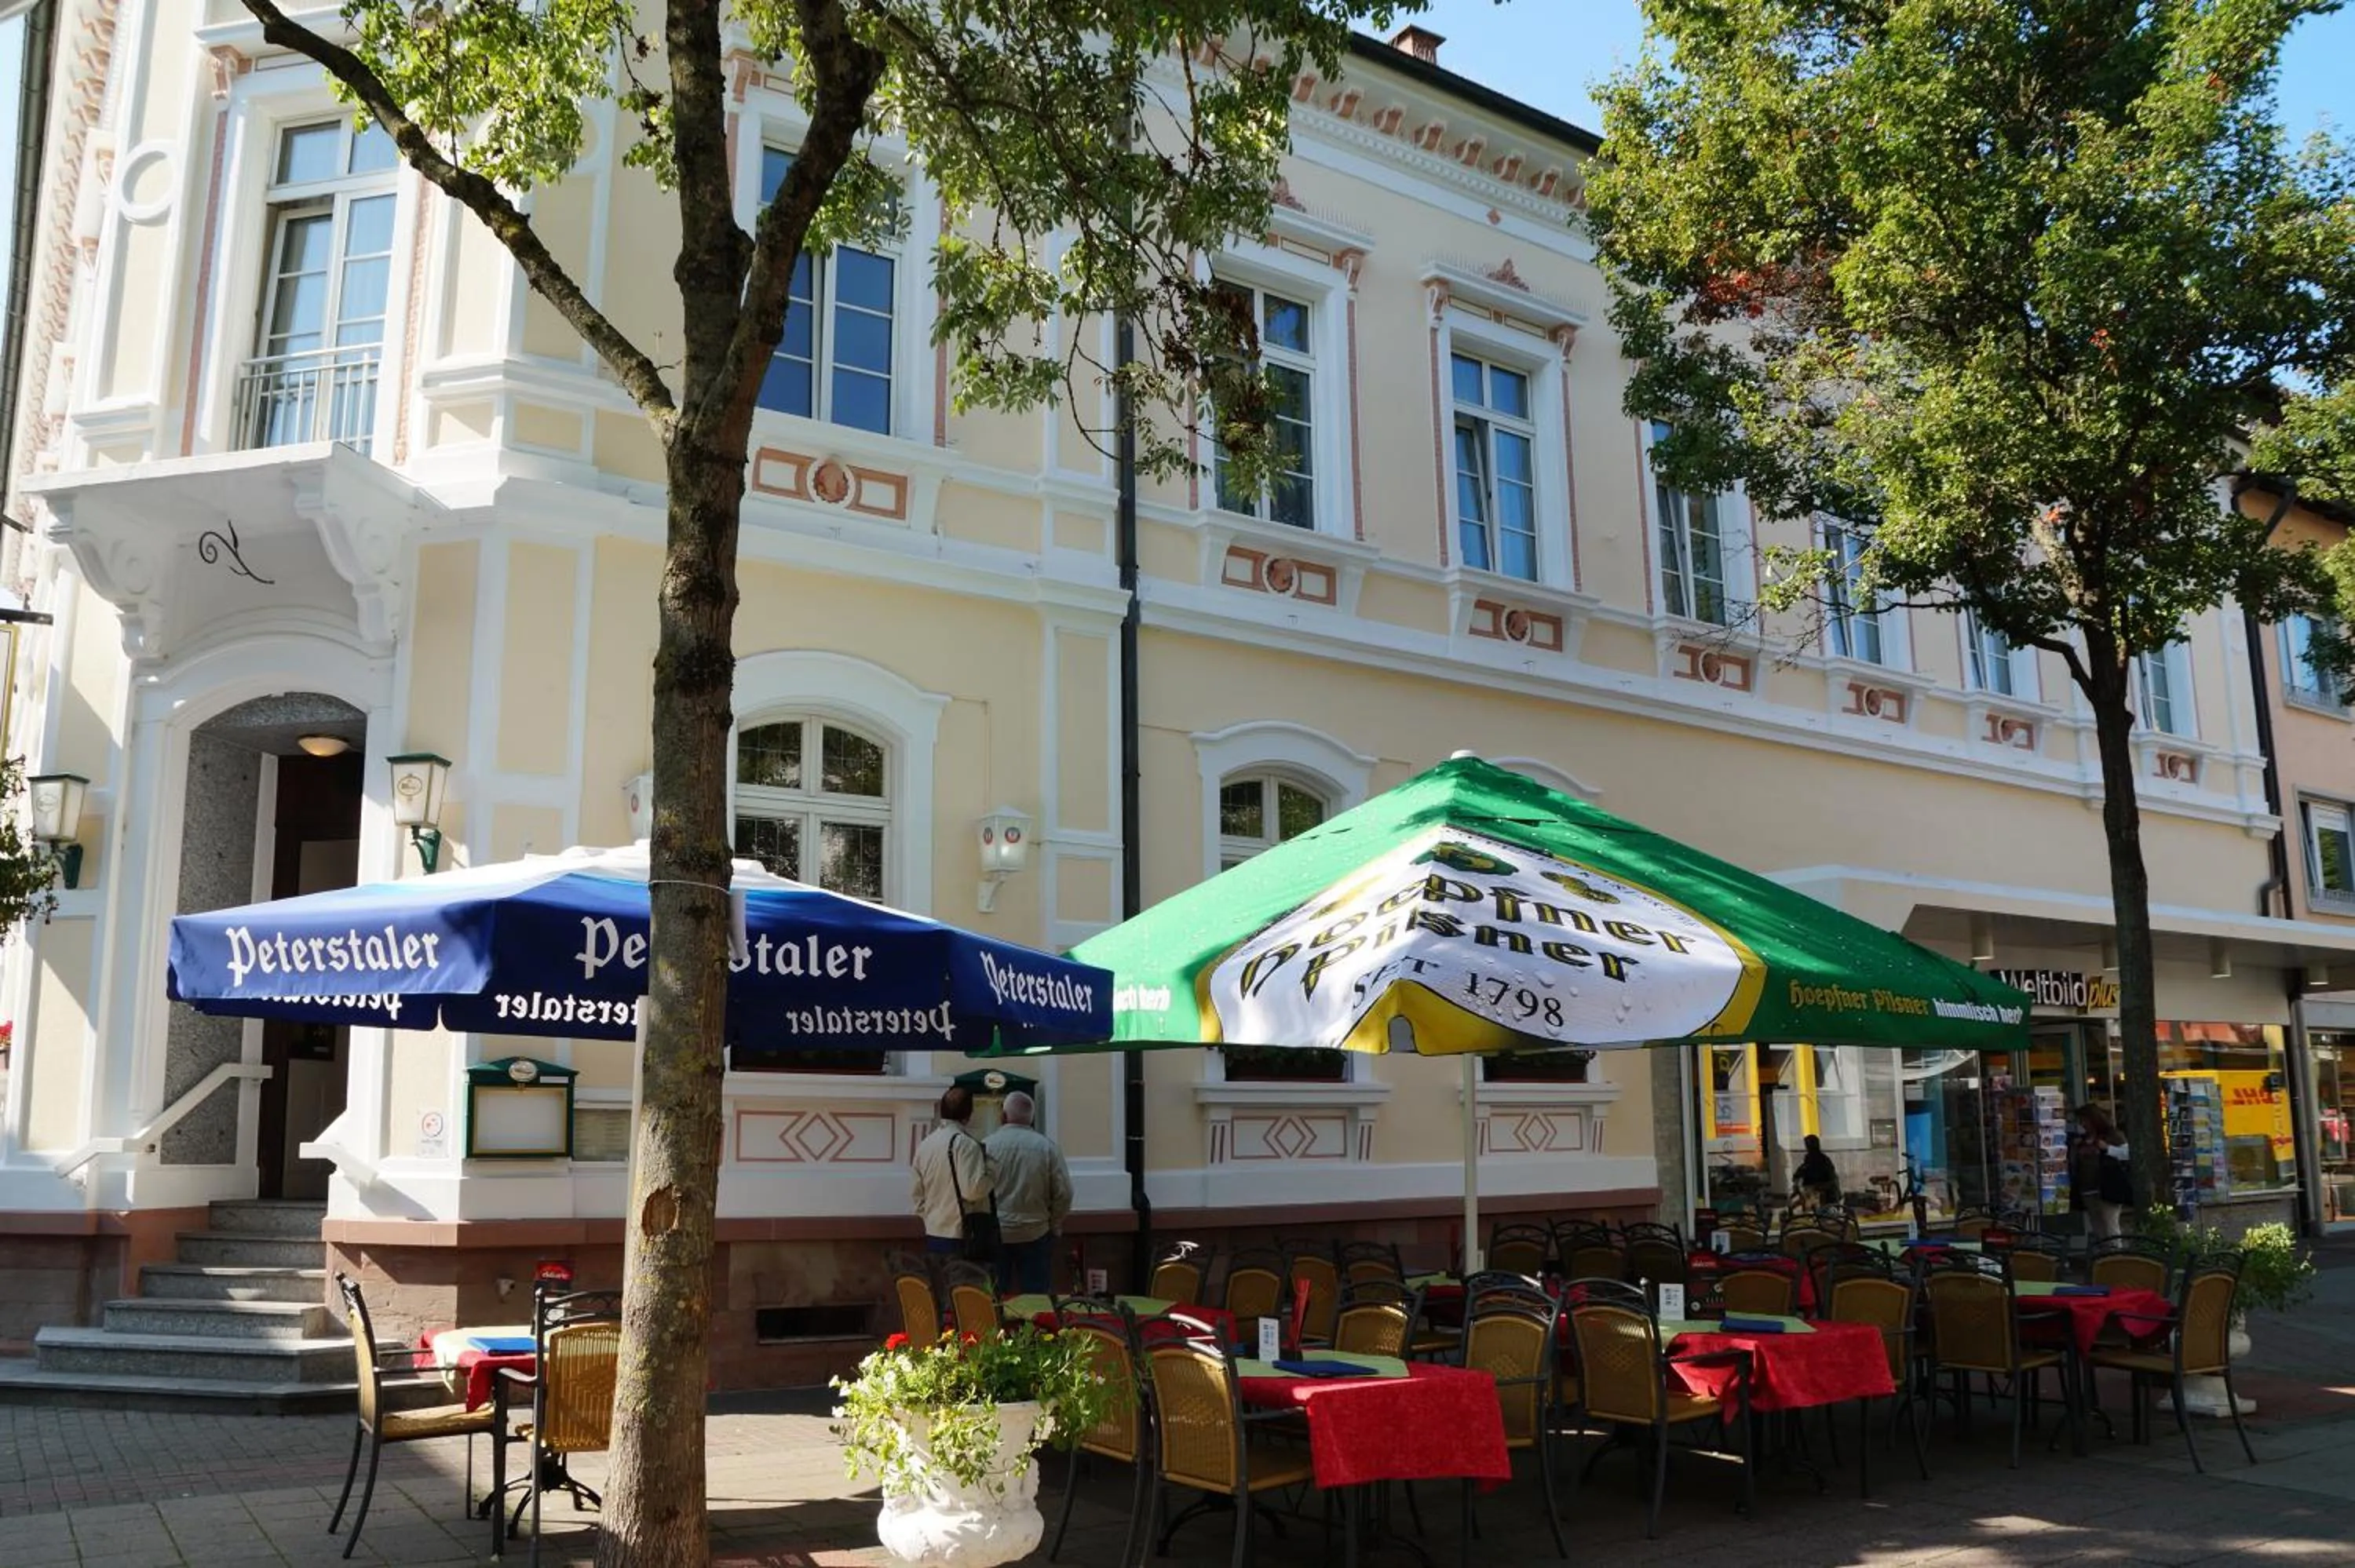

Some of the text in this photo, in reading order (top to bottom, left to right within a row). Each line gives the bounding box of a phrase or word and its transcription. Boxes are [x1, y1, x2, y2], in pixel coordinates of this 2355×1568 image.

[225, 924, 440, 987] Peterstaler
[980, 950, 1093, 1014] Peterstaler
[1466, 972, 1565, 1028] 1798
